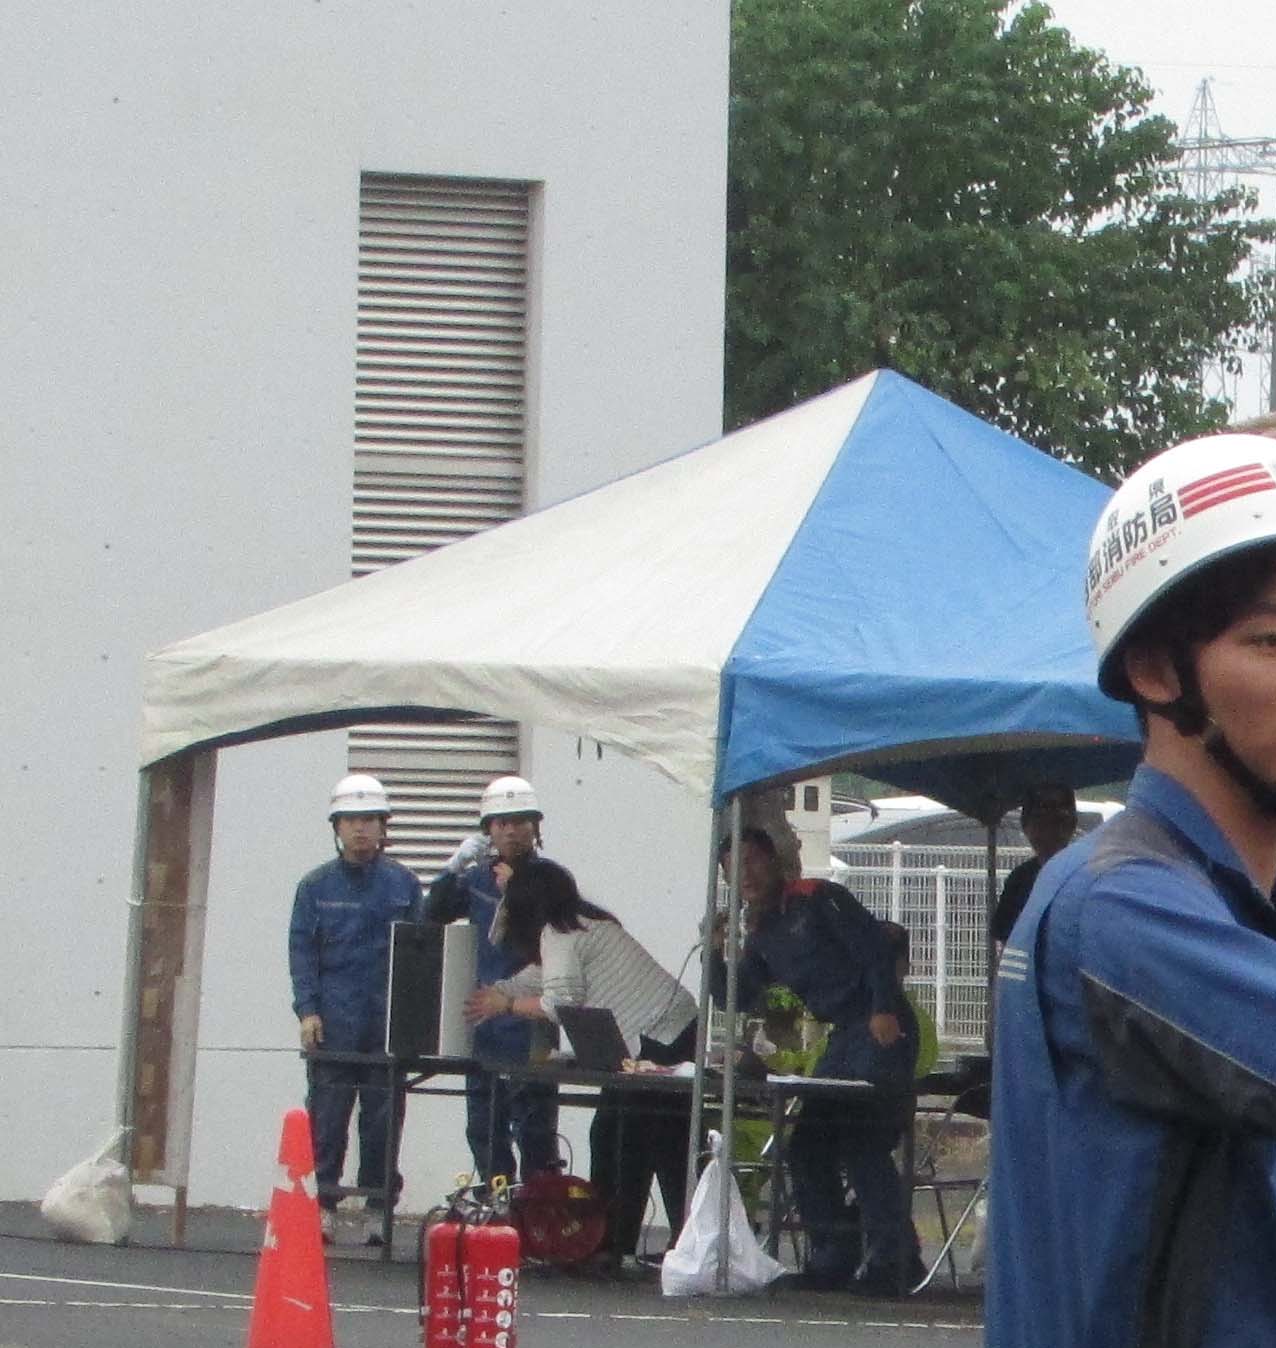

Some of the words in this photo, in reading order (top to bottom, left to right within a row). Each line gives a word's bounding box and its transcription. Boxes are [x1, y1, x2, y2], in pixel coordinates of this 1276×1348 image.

[1085, 494, 1177, 604] 部消防局
[1126, 550, 1146, 571] FIRE
[1149, 527, 1182, 550] DEPT.
